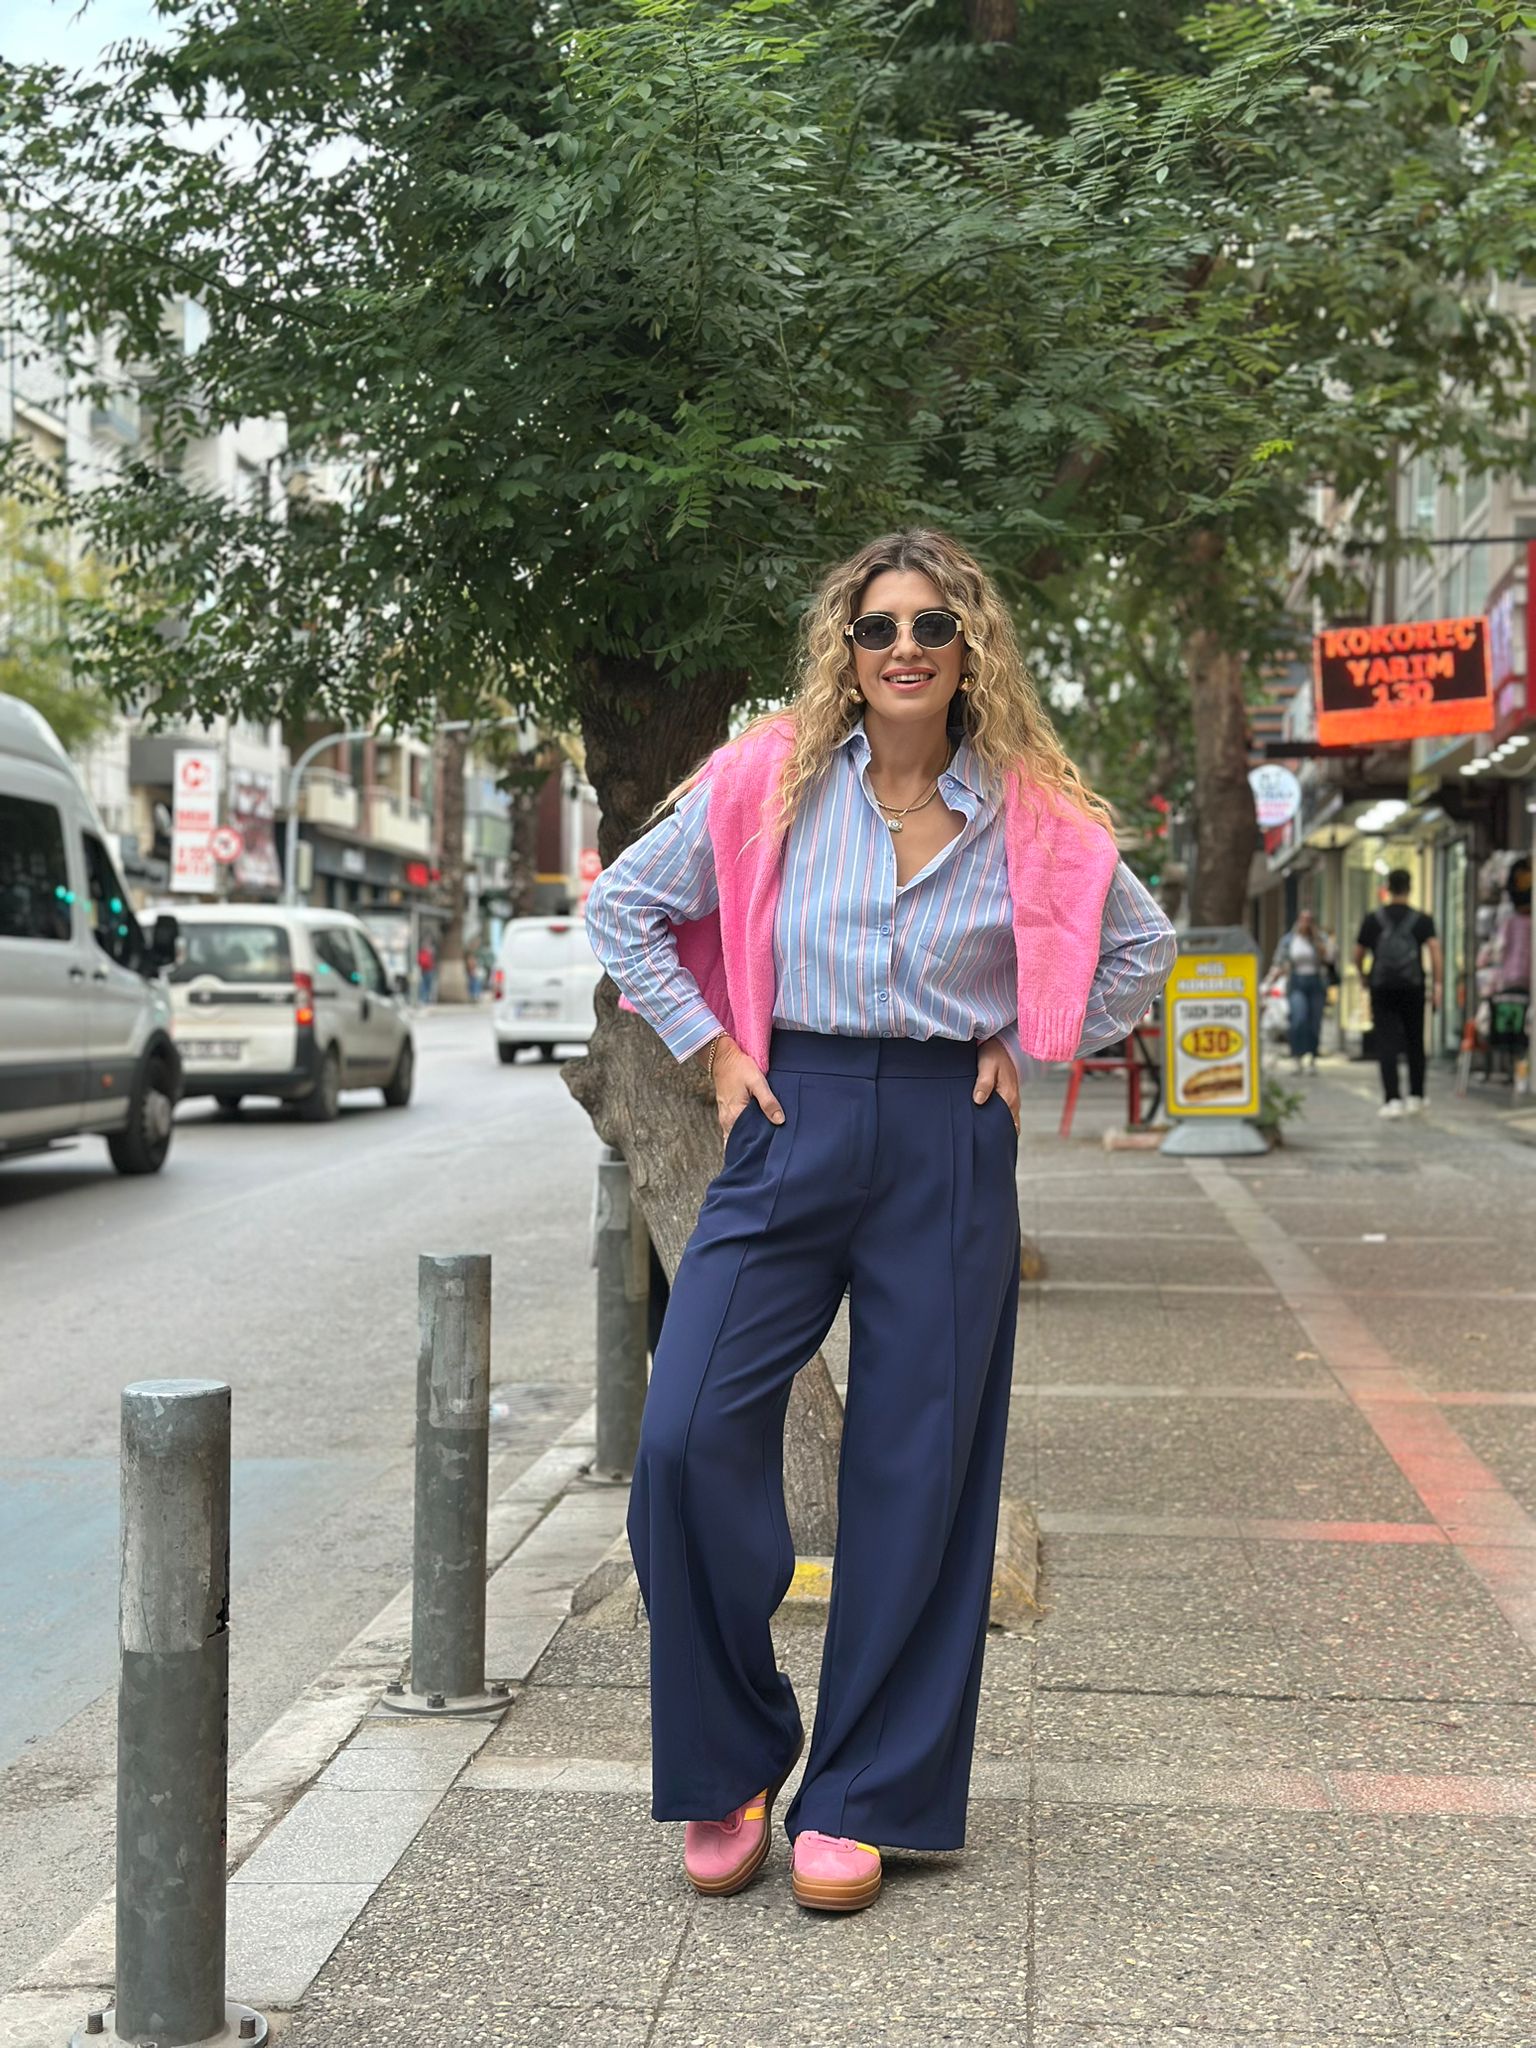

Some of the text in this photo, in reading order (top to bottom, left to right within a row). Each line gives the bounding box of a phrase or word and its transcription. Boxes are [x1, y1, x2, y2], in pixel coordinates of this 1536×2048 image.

[1323, 620, 1476, 658] KOKOREÇ
[1346, 651, 1455, 687] YARIM
[1371, 680, 1434, 709] 130
